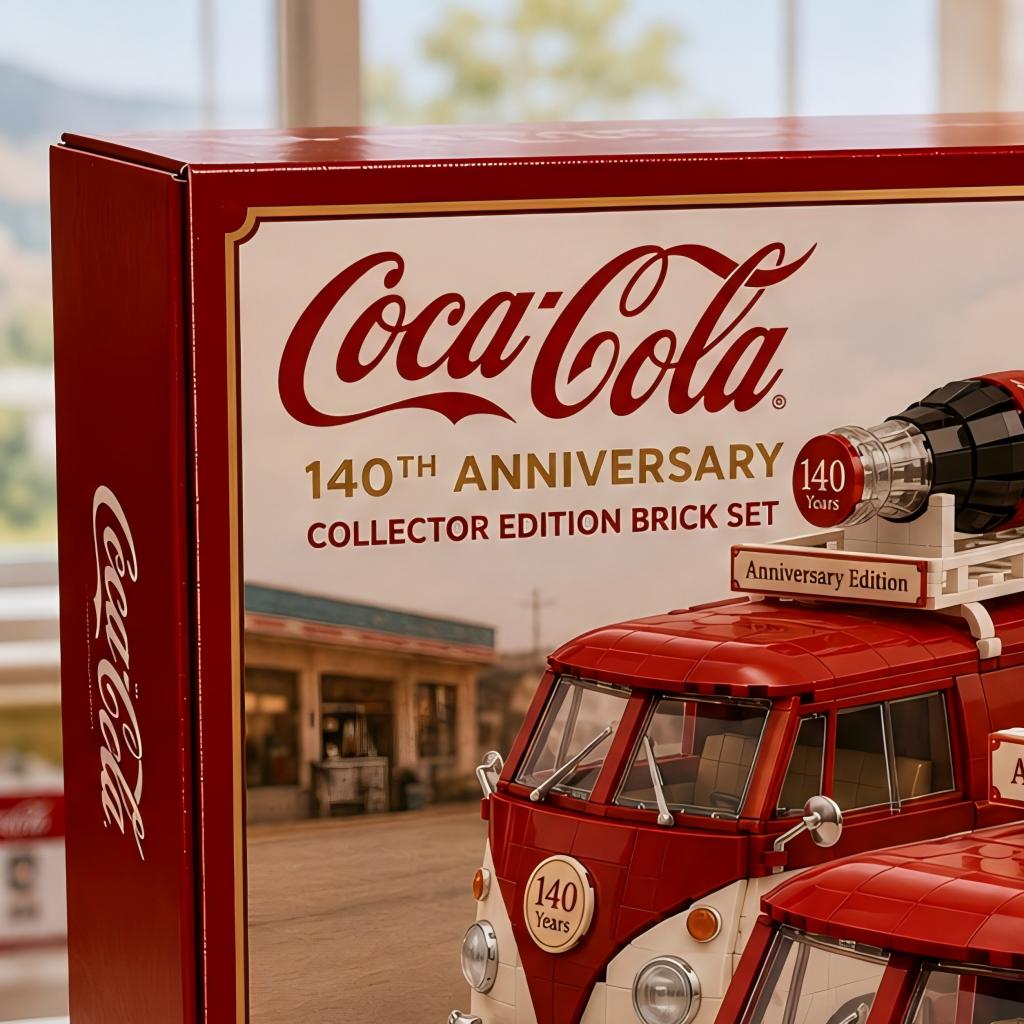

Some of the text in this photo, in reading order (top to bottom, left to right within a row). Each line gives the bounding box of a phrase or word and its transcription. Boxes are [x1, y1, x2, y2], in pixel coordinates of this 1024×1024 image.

[278, 242, 817, 427] Coca-Cola
[305, 442, 784, 500] 140TH ANNIVERSARY
[800, 458, 846, 493] 140
[307, 500, 780, 549] COLLECTOR EDITION BRICK SET
[745, 559, 908, 593] Anniversary Edition
[93, 485, 145, 861] Coca-Cola
[535, 876, 578, 913] 140
[535, 910, 571, 934] Years
